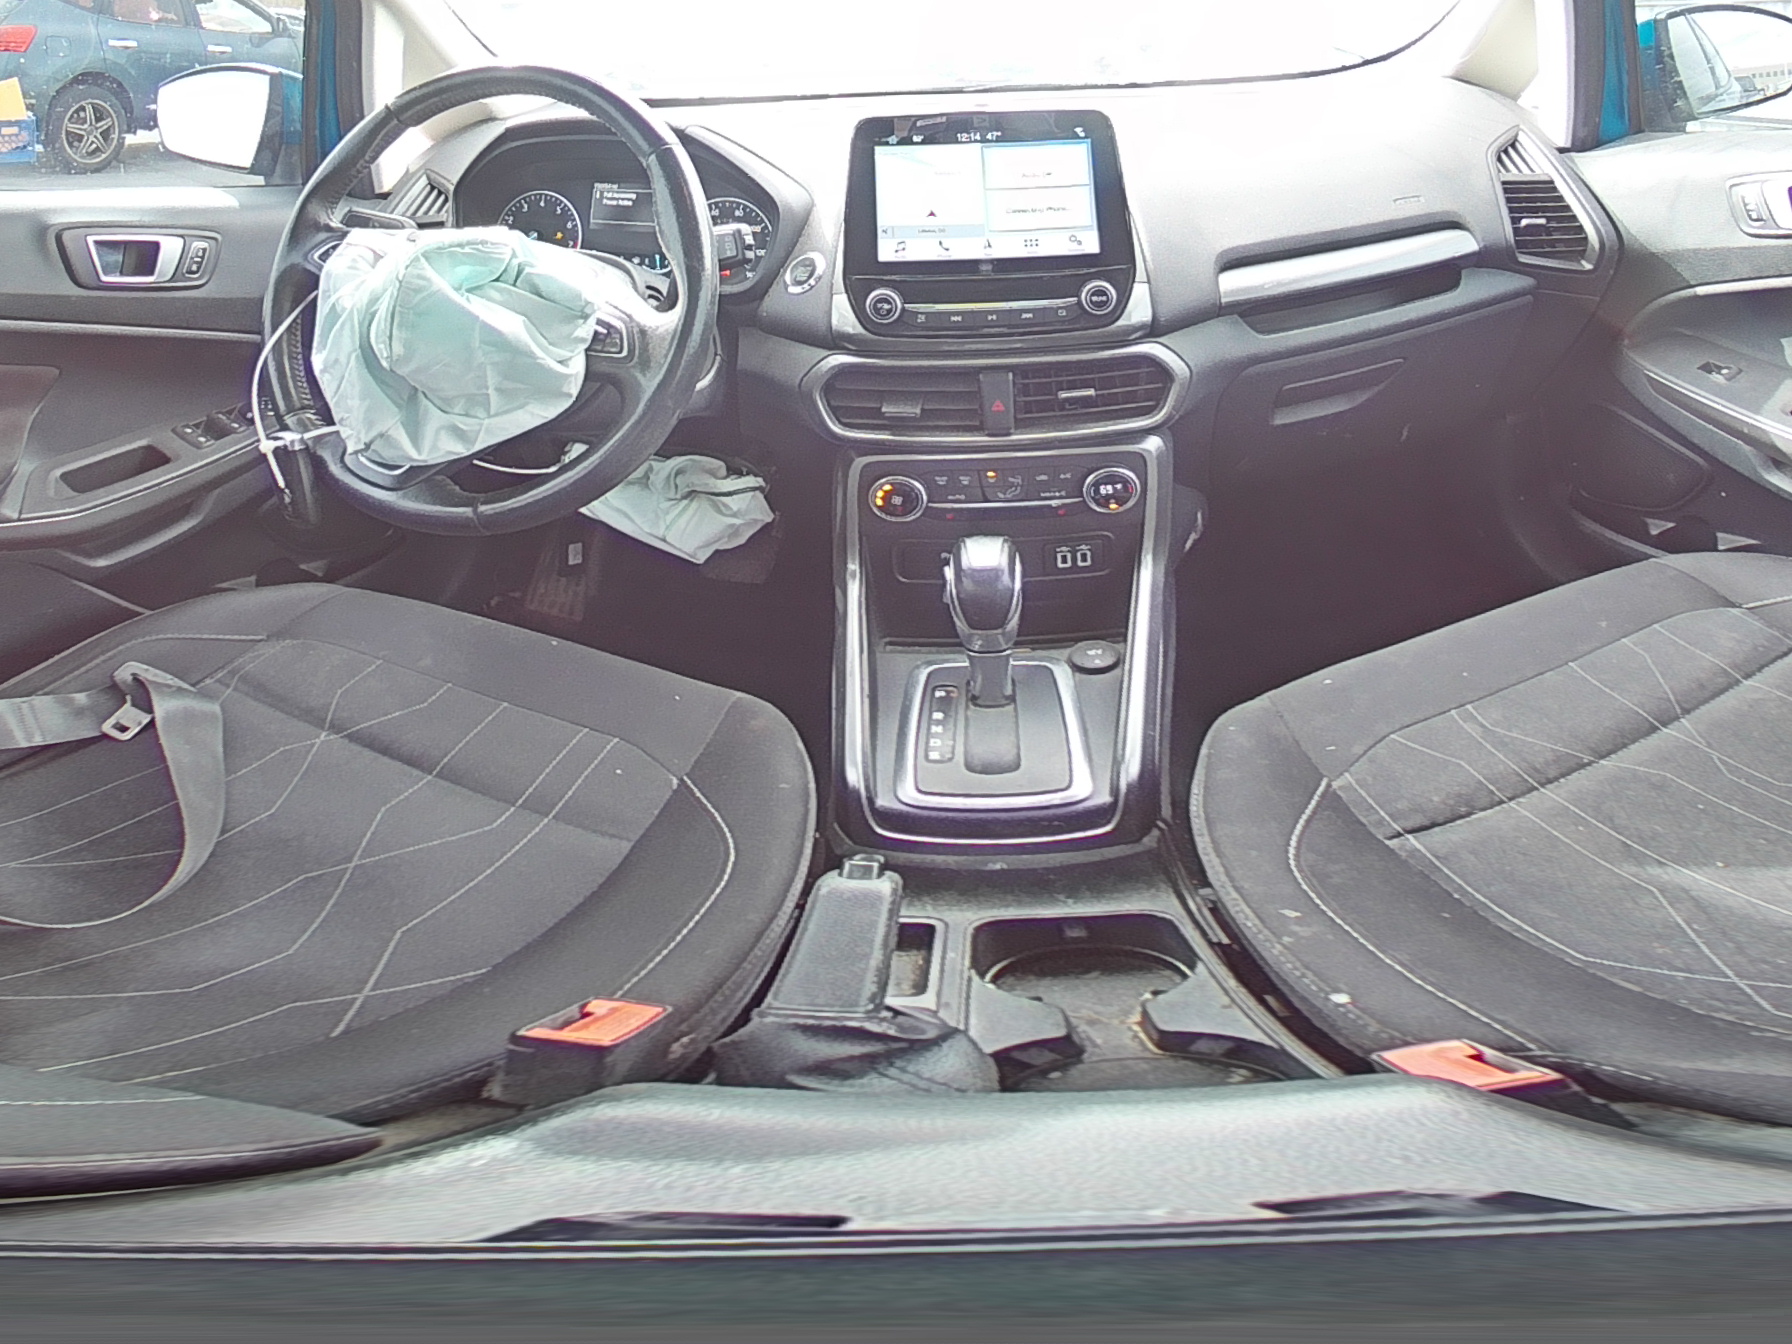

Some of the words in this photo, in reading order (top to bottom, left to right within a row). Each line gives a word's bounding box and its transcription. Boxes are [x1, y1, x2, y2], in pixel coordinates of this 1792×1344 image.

[956, 132, 981, 142] 12:14
[985, 131, 1002, 141] 47°
[929, 737, 942, 747] D
